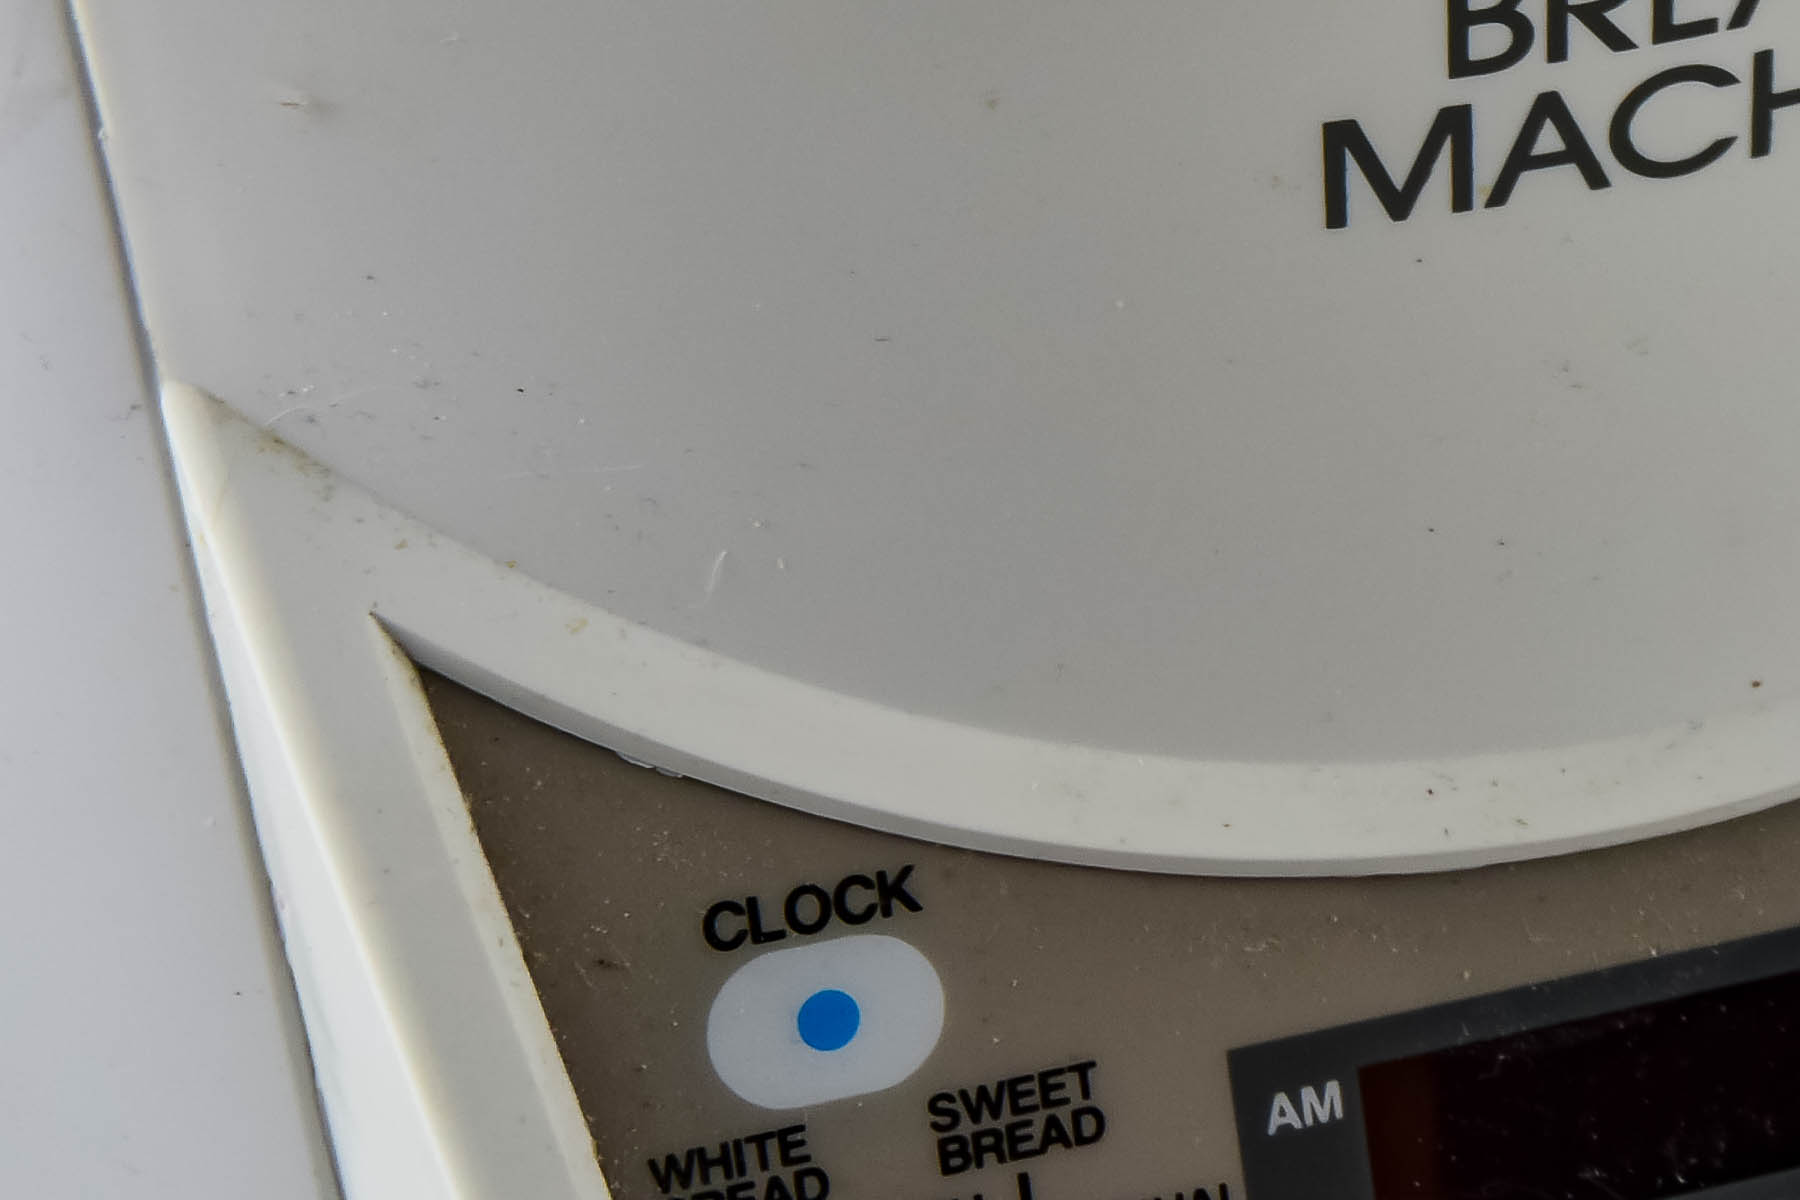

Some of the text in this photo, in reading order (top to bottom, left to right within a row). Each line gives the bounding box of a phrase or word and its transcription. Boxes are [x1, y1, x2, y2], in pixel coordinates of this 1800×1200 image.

[702, 864, 924, 952] CLOCK
[927, 1060, 1097, 1134] SWEET
[1267, 1079, 1344, 1136] AM
[647, 1124, 812, 1195] WHITE
[937, 1105, 1106, 1177] BREAD
